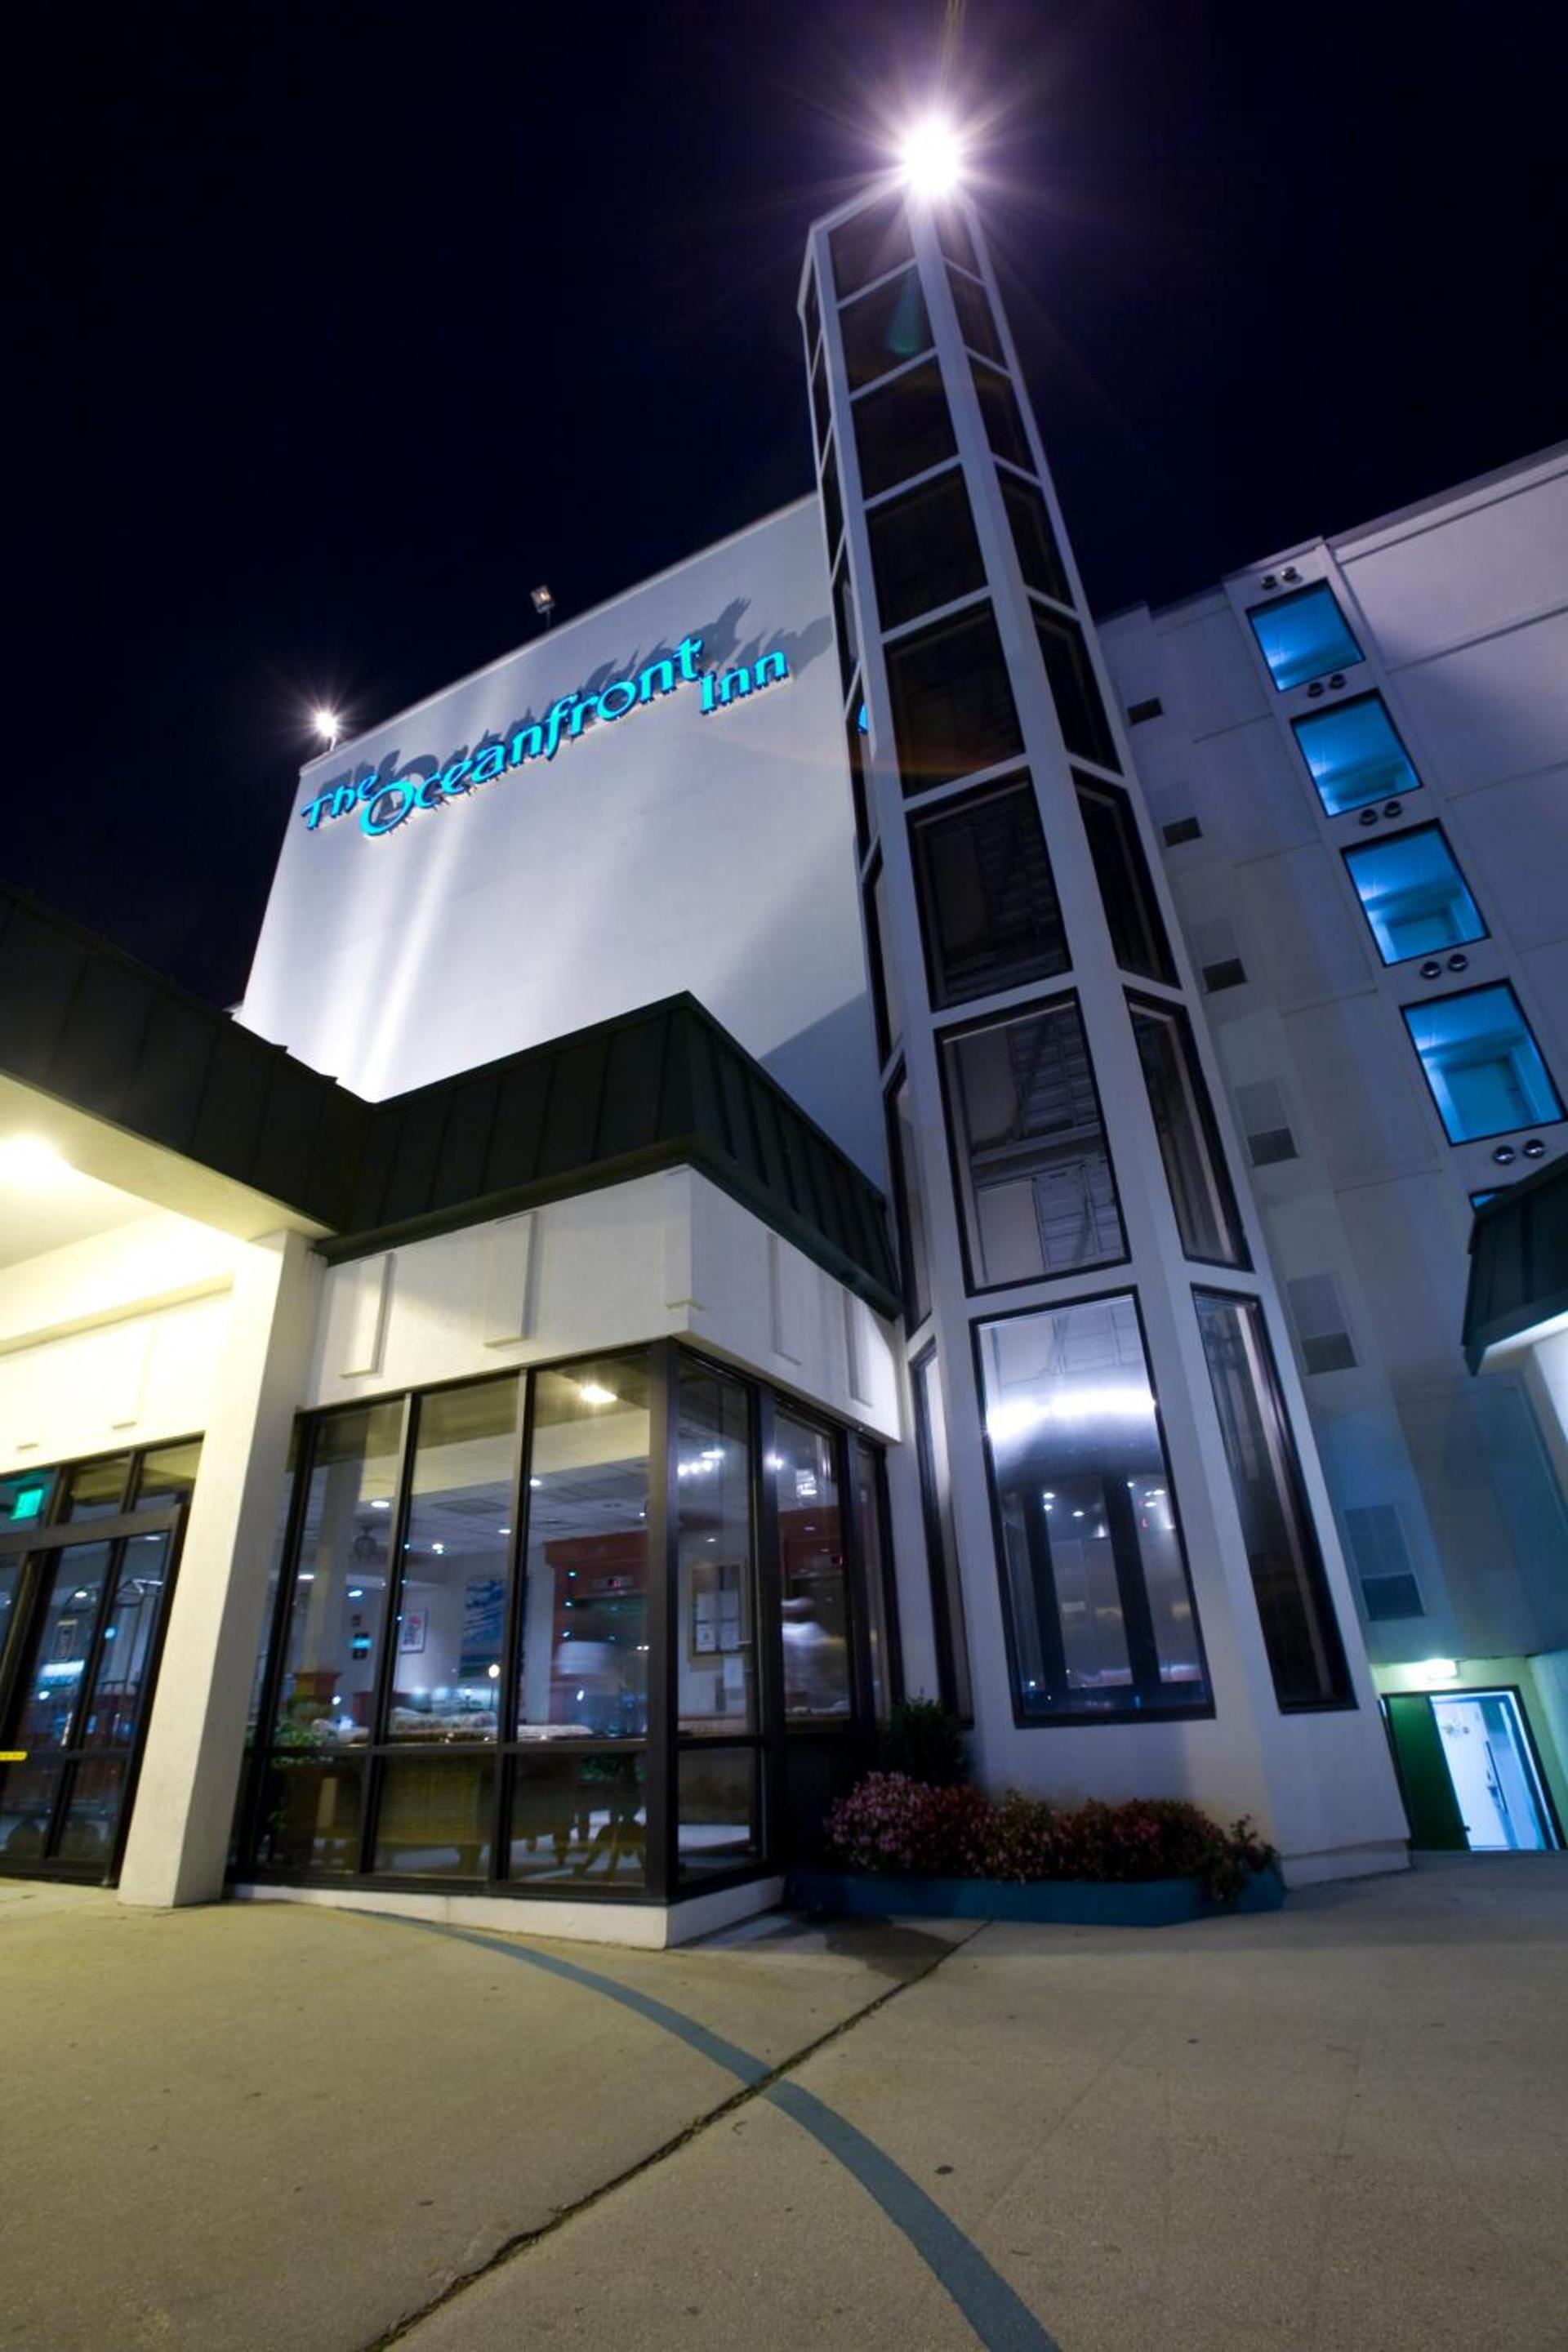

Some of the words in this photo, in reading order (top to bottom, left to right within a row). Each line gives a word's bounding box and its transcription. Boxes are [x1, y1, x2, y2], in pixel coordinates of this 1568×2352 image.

[301, 773, 378, 830] The
[359, 635, 705, 836] Oceanfront
[700, 651, 789, 715] Inn
